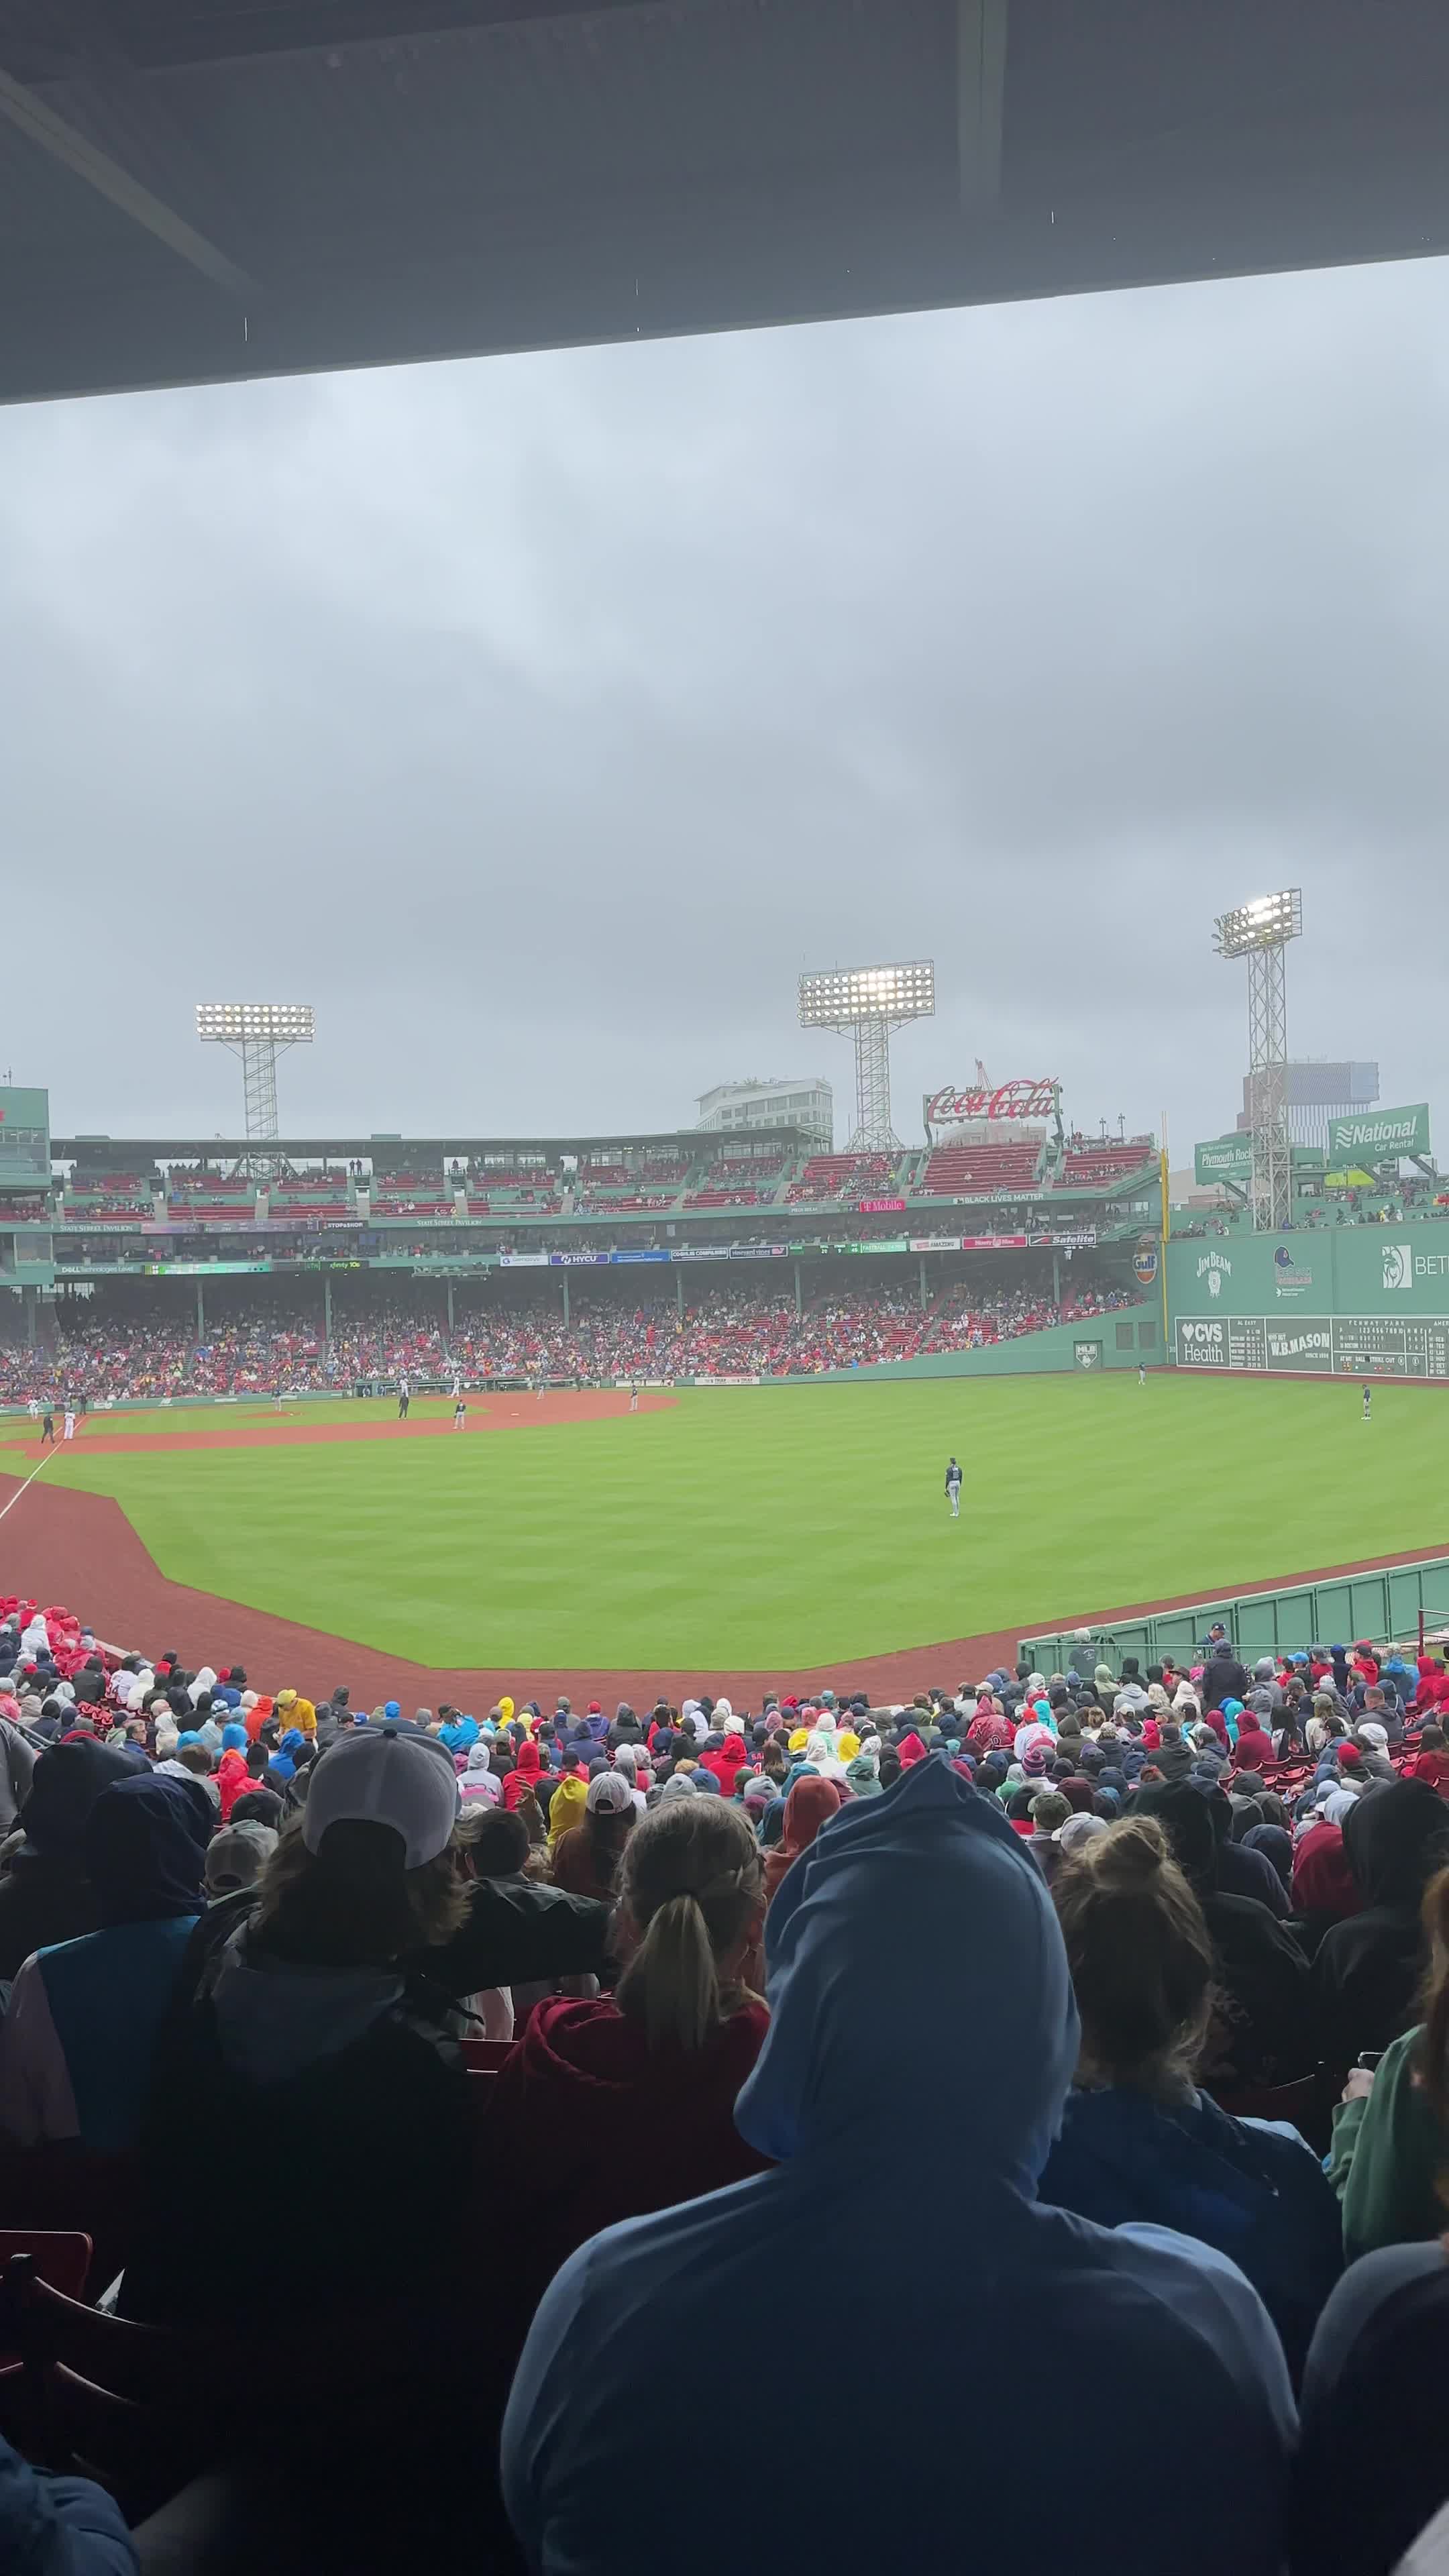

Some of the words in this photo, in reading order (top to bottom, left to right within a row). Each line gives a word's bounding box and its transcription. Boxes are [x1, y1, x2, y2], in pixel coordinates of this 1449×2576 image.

[1352, 1116, 1416, 1145] National
[1375, 1142, 1387, 1152] Car
[1389, 1139, 1414, 1150] Rental
[1202, 1150, 1234, 1166] Plymouth
[990, 1195, 1012, 1203] LIVES
[1014, 1193, 1043, 1202] MATTER
[1052, 1235, 1094, 1244] Safelite
[1134, 1255, 1155, 1269] Gulf
[1197, 1256, 1210, 1277] JIM
[1210, 1252, 1232, 1277] BEAM
[1415, 1256, 1449, 1275] BET
[1195, 1324, 1223, 1342] CVS
[1185, 1344, 1224, 1362] Health
